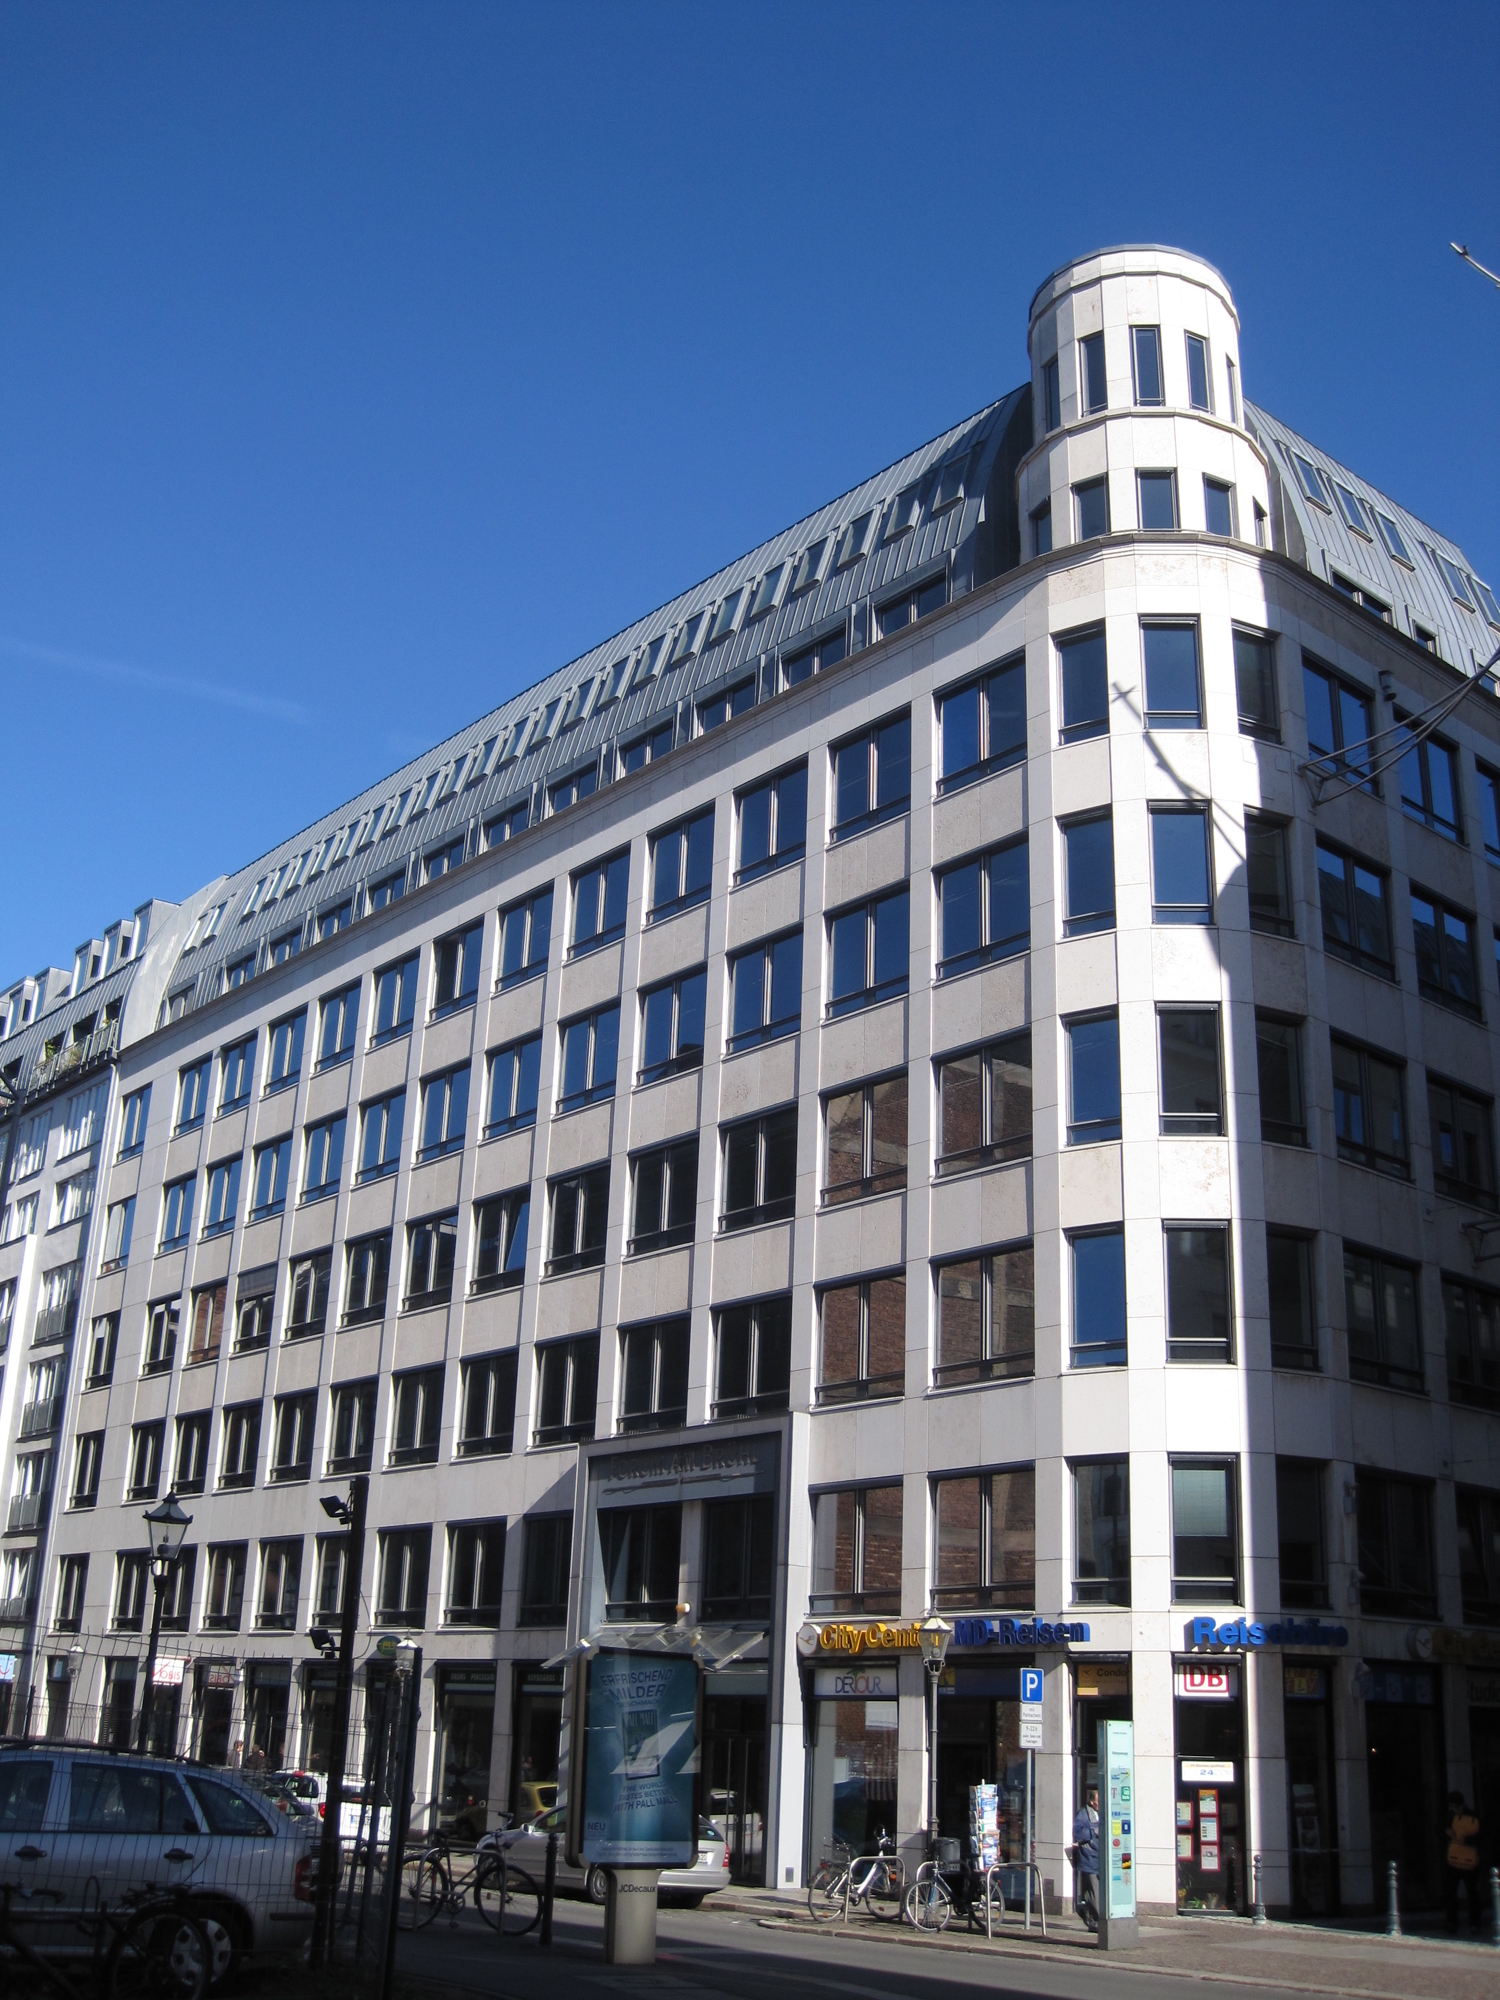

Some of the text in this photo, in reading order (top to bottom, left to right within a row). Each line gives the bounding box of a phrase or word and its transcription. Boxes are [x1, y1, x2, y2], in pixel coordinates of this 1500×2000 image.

[668, 1451, 696, 1473] AM
[701, 1440, 760, 1470] BRÜHL
[819, 1622, 938, 1654] City Cent
[954, 1618, 1090, 1646] MD-Reisen
[1192, 1616, 1349, 1647] Reisebüro
[600, 1668, 673, 1686] ERFRISCHEND
[835, 1668, 883, 1694] DERTOUR
[1026, 1673, 1038, 1698] P
[1189, 1664, 1223, 1687] DB
[608, 1684, 667, 1700] MILDER
[623, 1780, 667, 1792] THE WORLD
[644, 1788, 670, 1798] BETTER
[613, 1796, 678, 1812] WITH PALL MALL
[587, 1822, 606, 1831] NEU
[618, 1884, 656, 1893] JCDecaux
